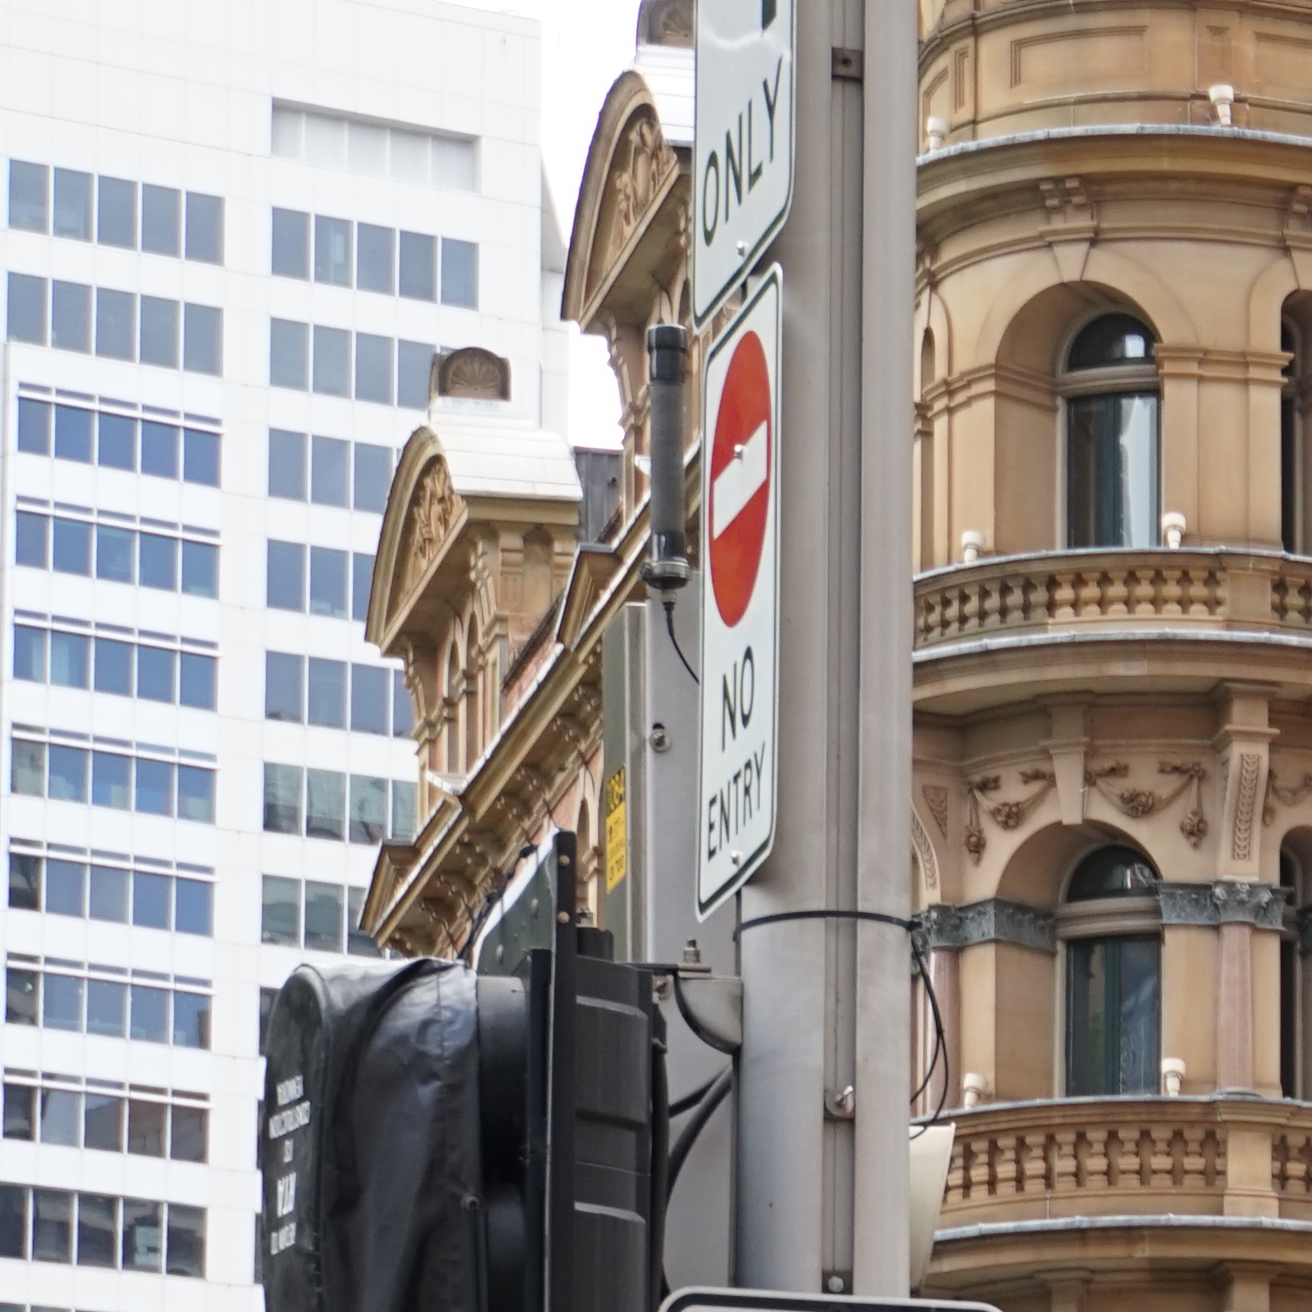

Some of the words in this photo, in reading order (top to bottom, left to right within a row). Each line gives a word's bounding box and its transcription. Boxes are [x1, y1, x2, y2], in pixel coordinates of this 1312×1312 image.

[703, 56, 783, 247] ONLY
[721, 645, 755, 753] NO
[708, 740, 766, 863] ENTRY
